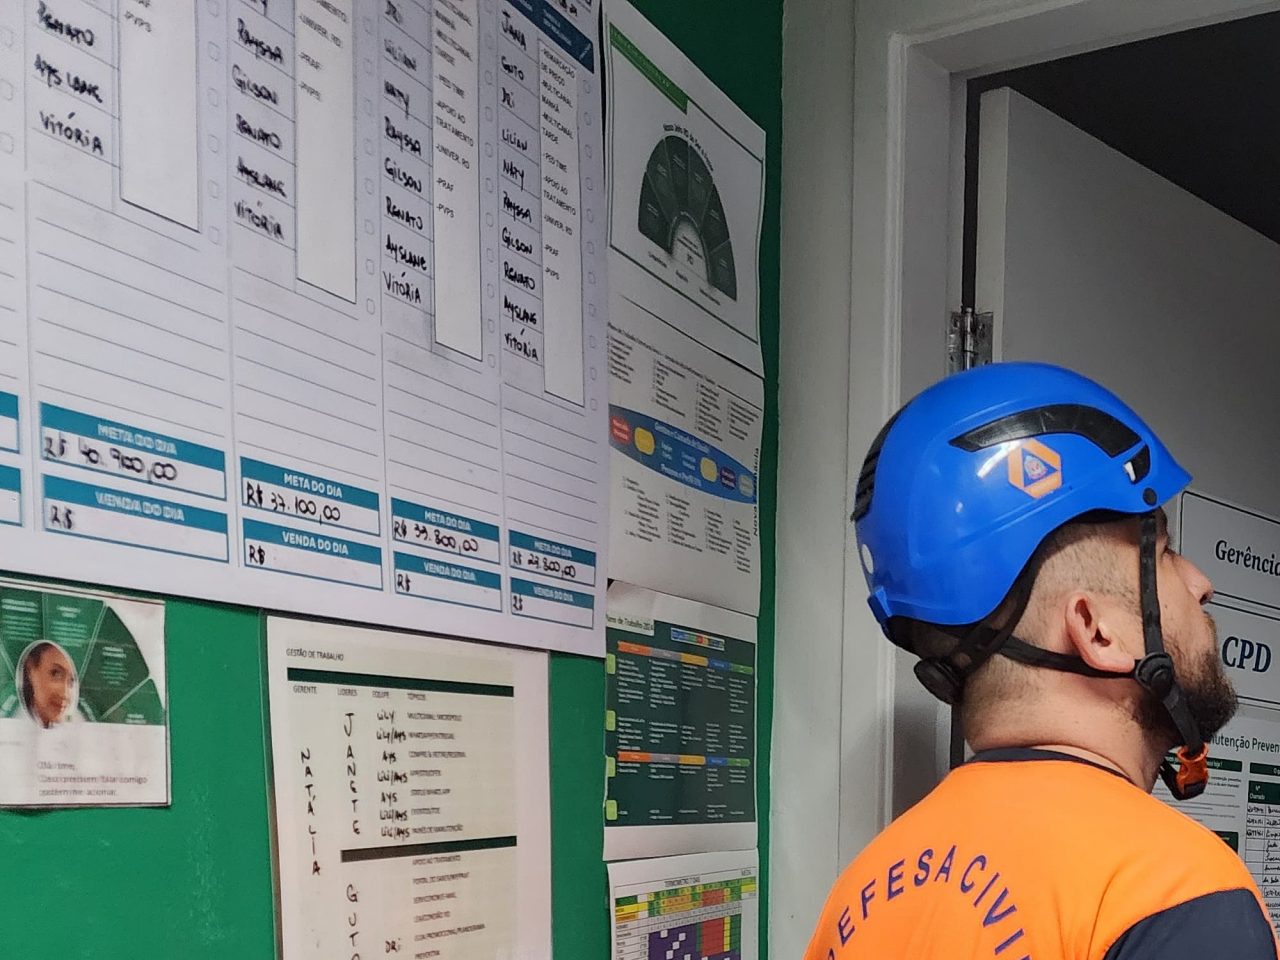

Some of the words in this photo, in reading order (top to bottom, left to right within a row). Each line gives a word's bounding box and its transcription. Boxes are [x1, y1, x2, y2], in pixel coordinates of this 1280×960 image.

[97, 424, 133, 446] META
[134, 432, 153, 449] DO
[155, 438, 178, 456] DIA
[283, 472, 311, 489] META
[312, 479, 327, 494] DO
[328, 483, 343, 498] DIA
[95, 491, 140, 514] VENDA
[143, 500, 162, 517] DO
[163, 505, 185, 522] DIA
[424, 510, 446, 524] META
[446, 515, 458, 527] DO
[458, 518, 472, 531] DIA
[282, 531, 316, 547] VENDA
[317, 537, 332, 551] DO
[333, 541, 348, 556] DIA
[424, 562, 449, 577] VENDA
[450, 568, 461, 579] DO
[462, 569, 476, 582] DIA
[286, 648, 307, 658] GESTÃO
[308, 650, 315, 659] DE
[315, 651, 344, 661] TRABALHO
[1221, 635, 1272, 674] CPD
[293, 685, 317, 694] GERENTE
[1210, 734, 1250, 752] nutenção
